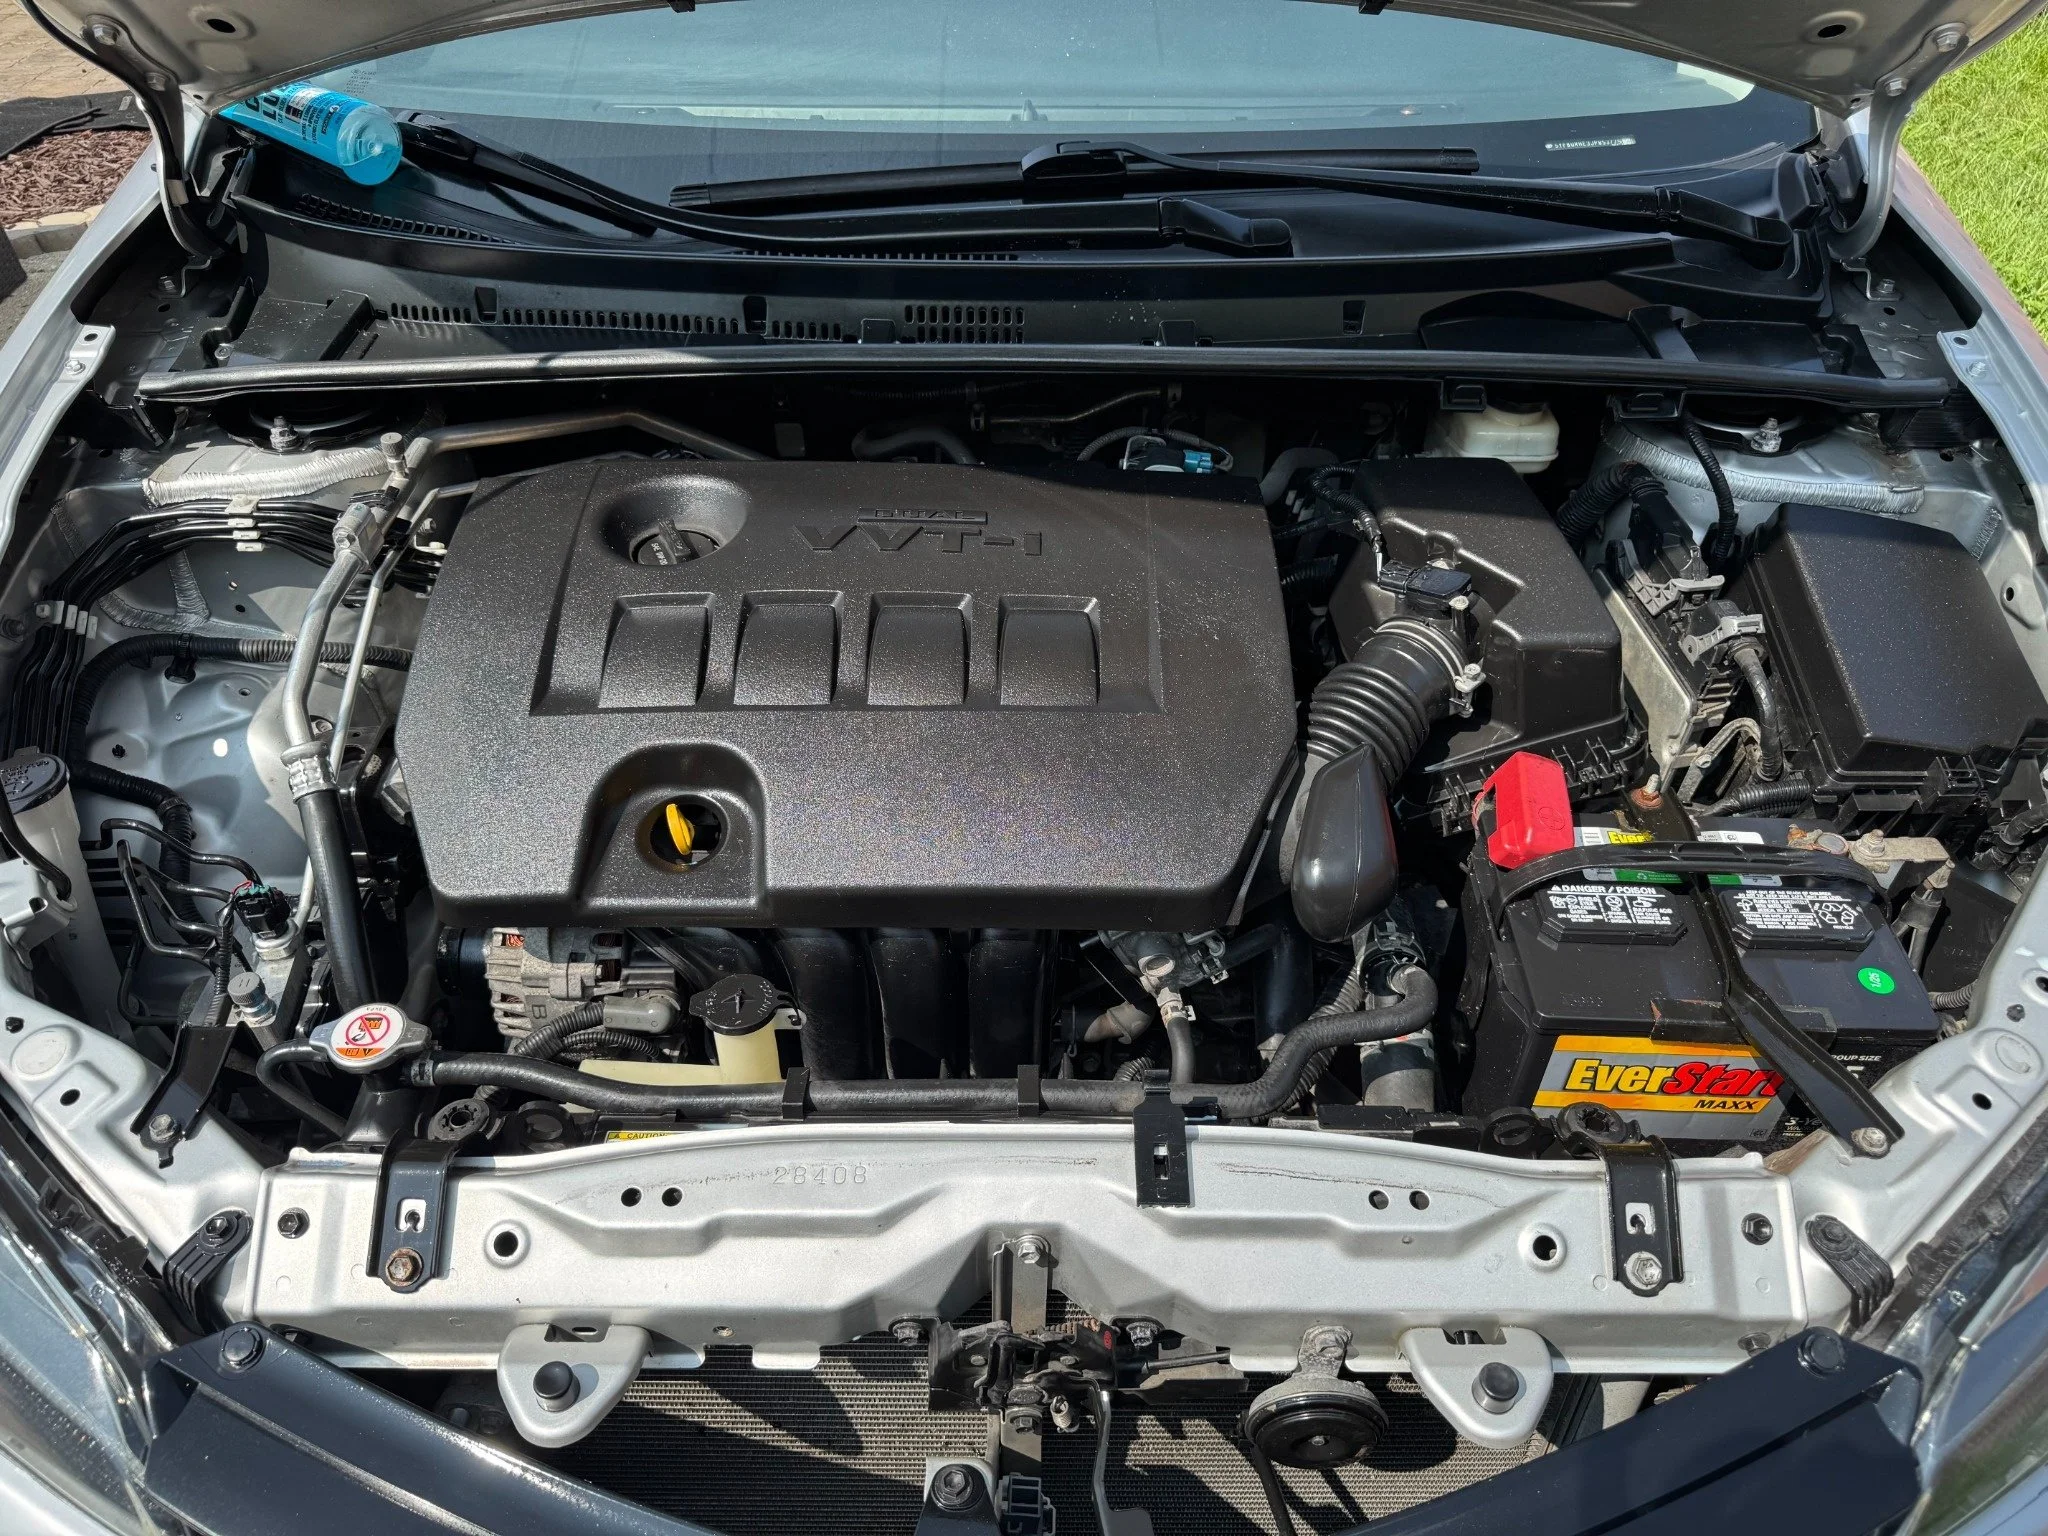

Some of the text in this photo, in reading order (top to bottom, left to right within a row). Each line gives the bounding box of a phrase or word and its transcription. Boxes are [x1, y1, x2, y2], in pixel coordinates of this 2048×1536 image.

[875, 509, 975, 519] DUAL
[1561, 884, 1656, 894] DANGER / POISON
[1694, 1099, 1760, 1111] MAXX
[773, 1165, 867, 1184] 28408
